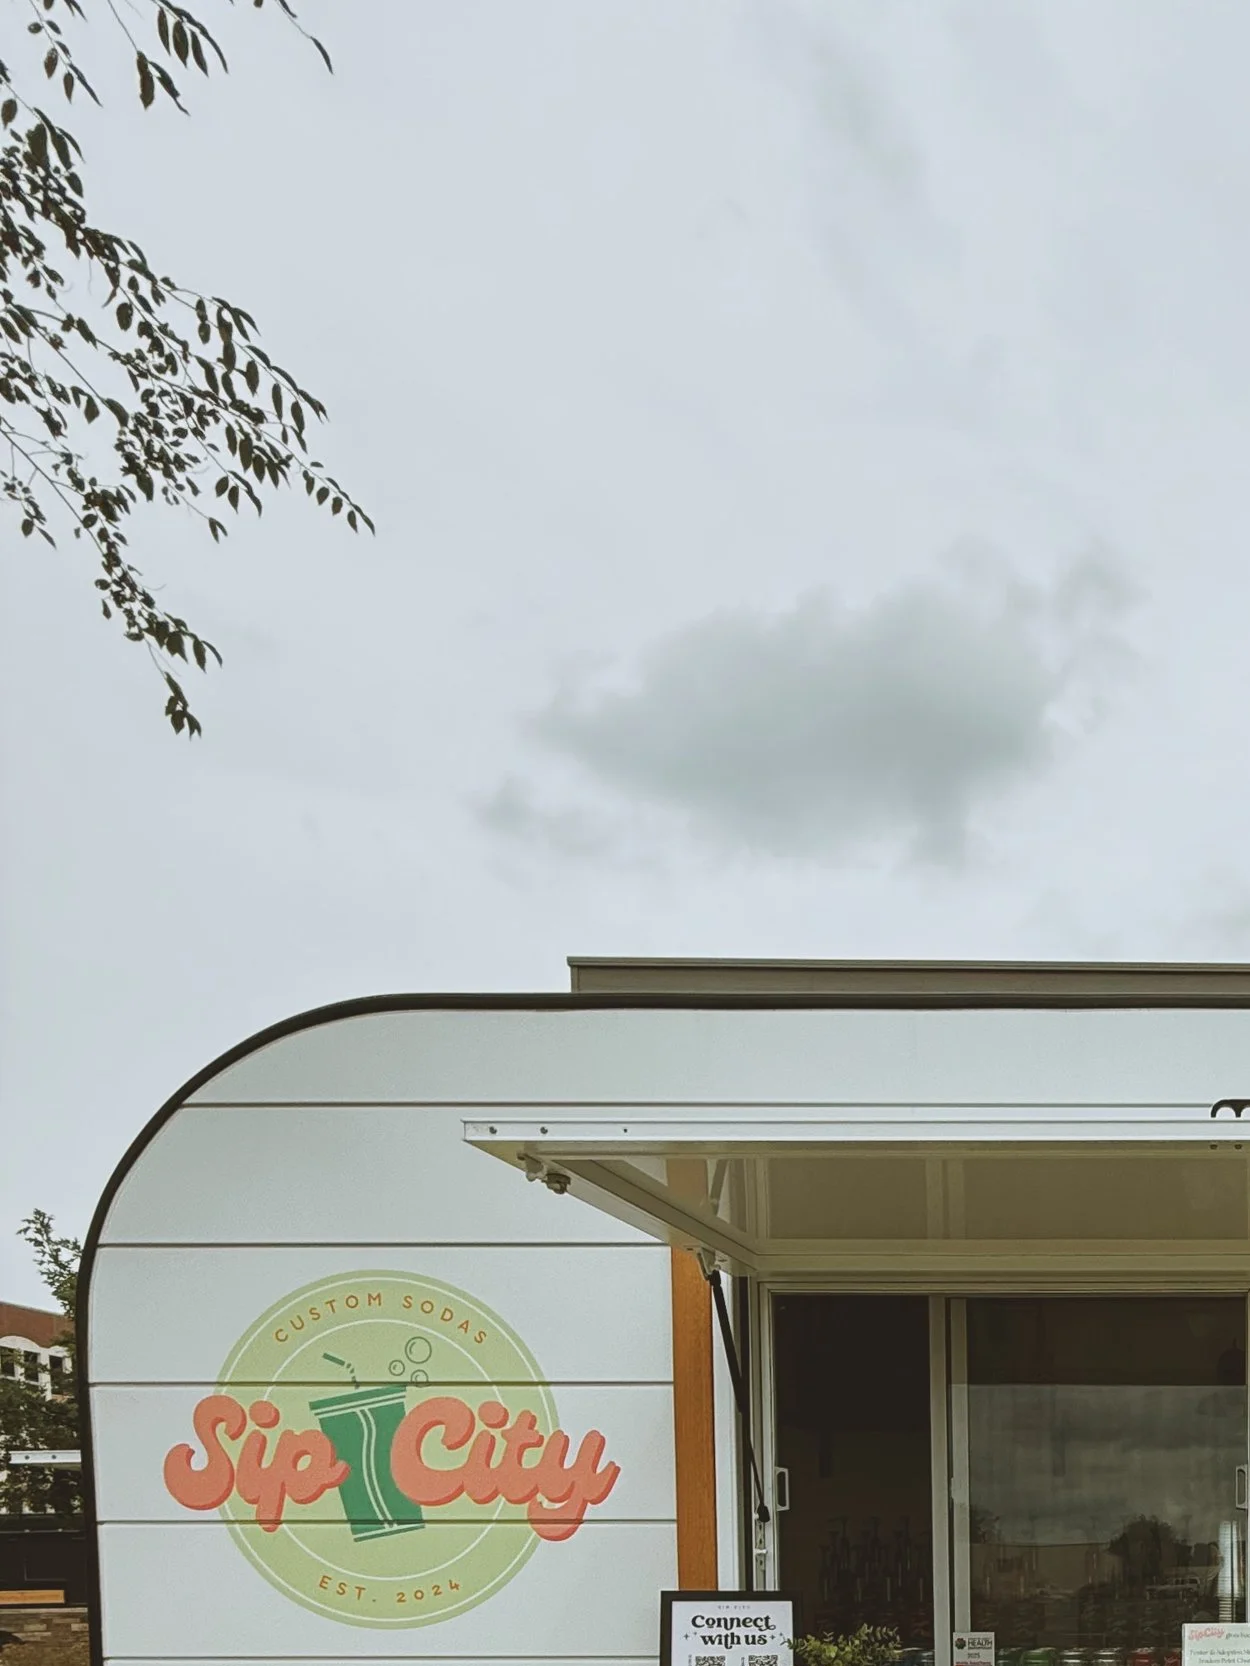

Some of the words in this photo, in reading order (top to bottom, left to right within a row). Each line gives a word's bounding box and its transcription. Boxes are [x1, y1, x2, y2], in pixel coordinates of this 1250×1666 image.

[274, 1292, 383, 1343] CUSTOM
[402, 1294, 488, 1344] SODAS
[163, 1394, 351, 1533] Sip
[390, 1396, 621, 1541] City
[318, 1575, 377, 1603] EST.
[396, 1580, 461, 1603] 2024
[691, 1615, 776, 1631] Connect
[700, 1632, 741, 1649] with
[744, 1634, 767, 1645] us
